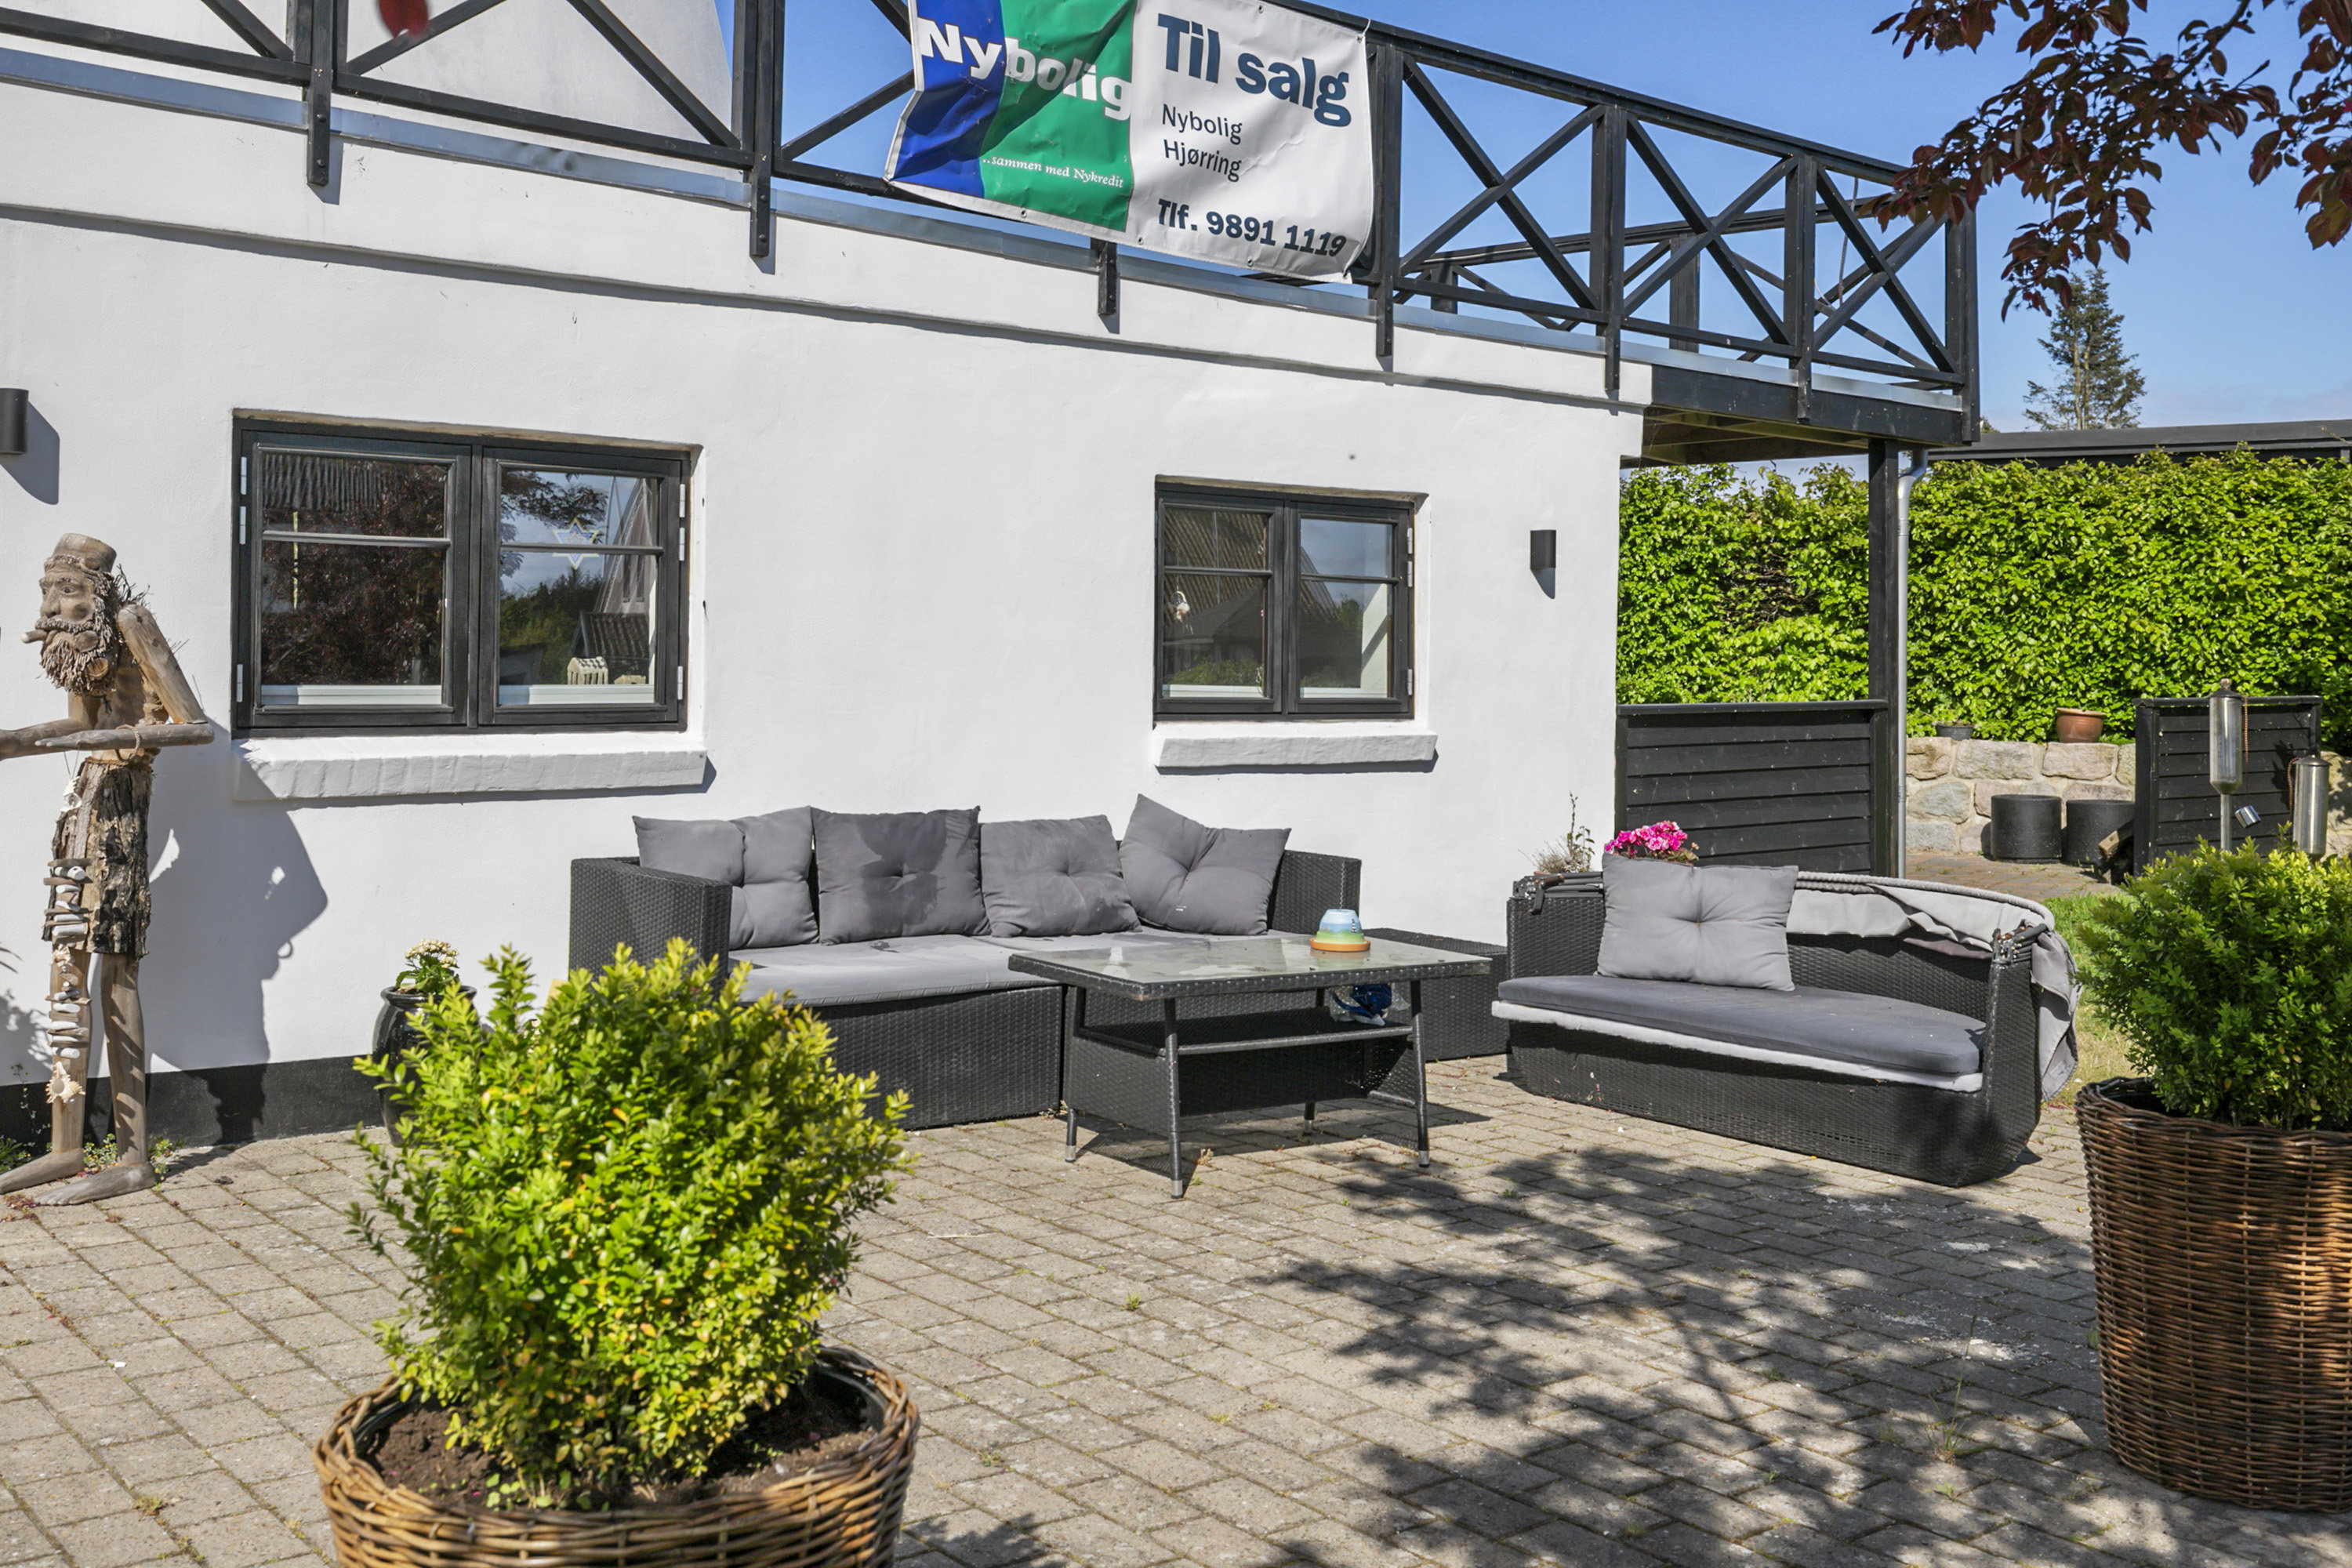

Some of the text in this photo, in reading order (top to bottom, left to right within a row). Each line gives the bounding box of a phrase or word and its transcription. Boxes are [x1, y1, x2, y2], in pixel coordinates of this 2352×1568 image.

[916, 16, 1132, 121] Nybolig
[1158, 13, 1352, 127] Til salg
[1162, 103, 1243, 145] Nybolig
[1045, 165, 1070, 178] med
[1073, 169, 1124, 188] Nykredit
[1163, 139, 1242, 182] Hjørring
[1158, 198, 1347, 258] Tlf. 9891 1119
